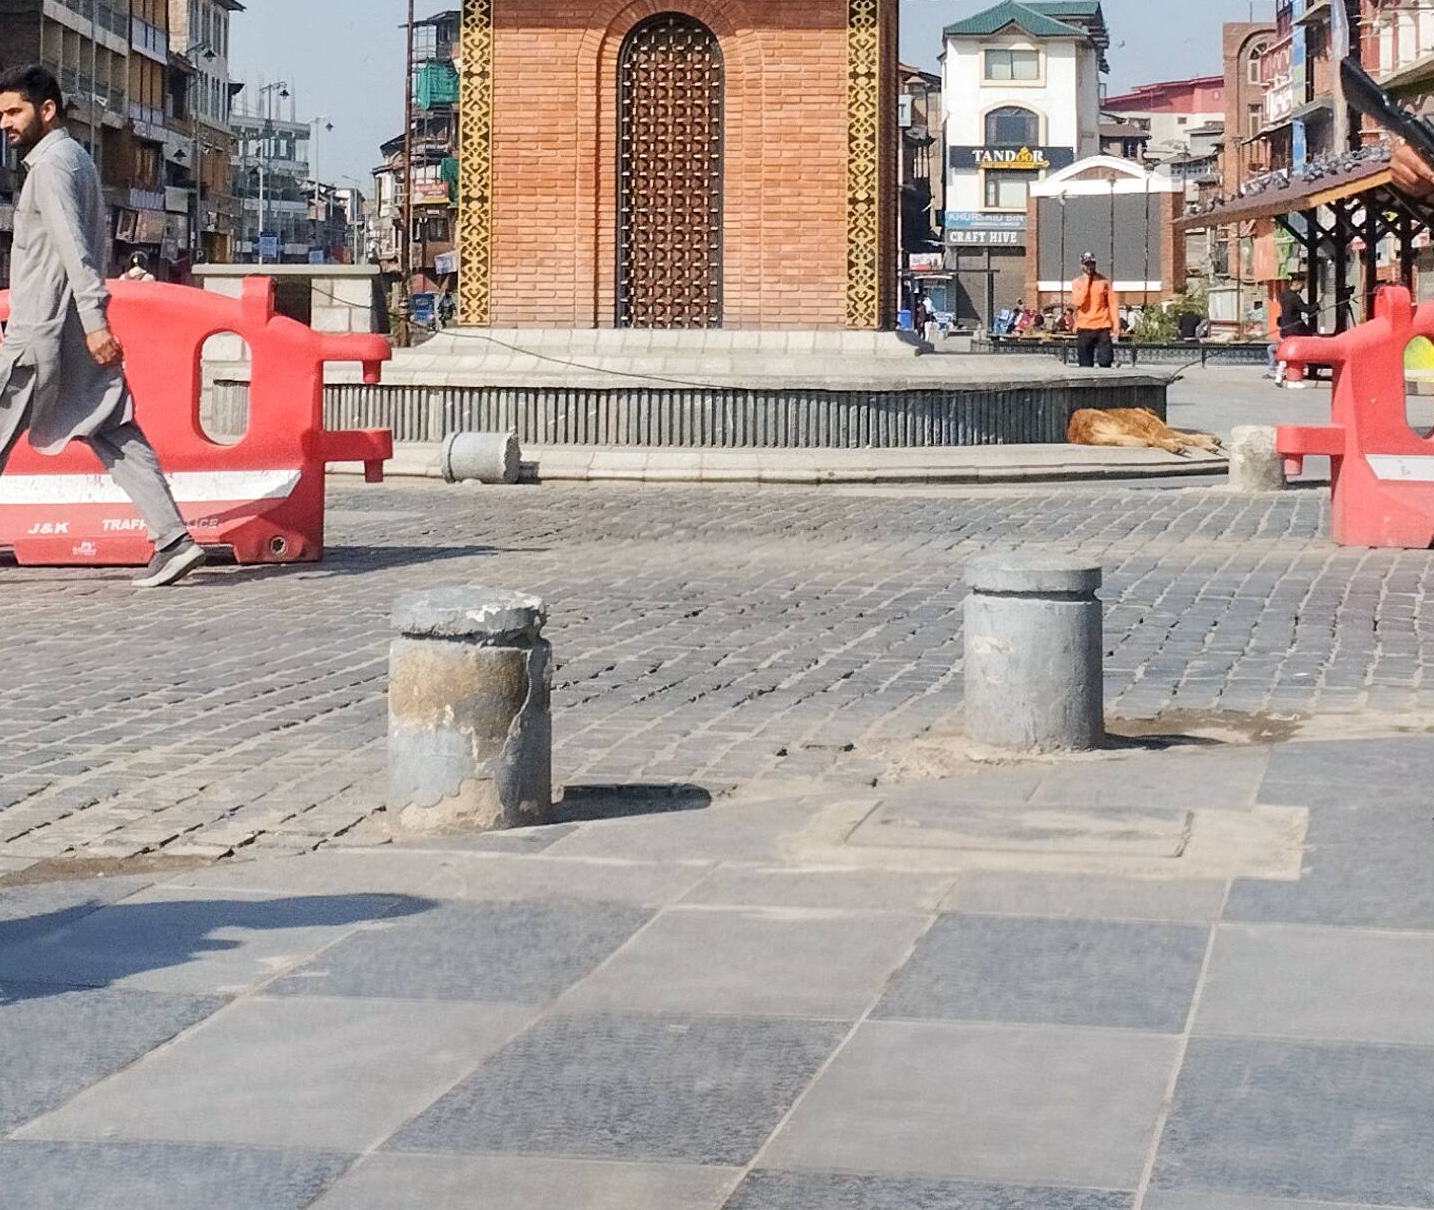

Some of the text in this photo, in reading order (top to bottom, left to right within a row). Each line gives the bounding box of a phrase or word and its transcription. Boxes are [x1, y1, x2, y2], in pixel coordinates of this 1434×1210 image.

[972, 148, 1045, 163] TANDOOR
[949, 231, 1018, 244] CRAFT HIVE
[27, 521, 69, 534] J&K
